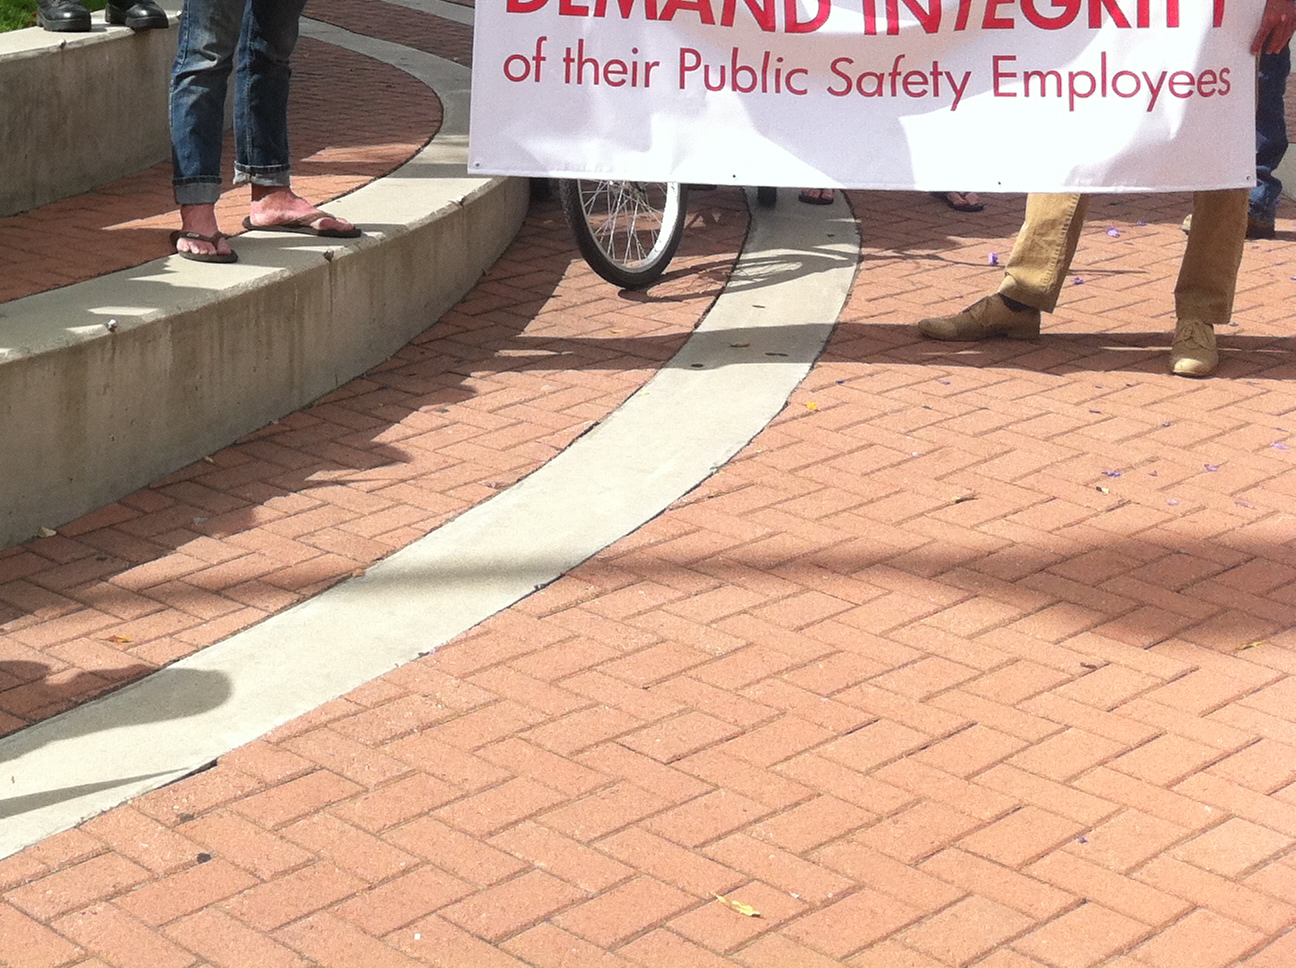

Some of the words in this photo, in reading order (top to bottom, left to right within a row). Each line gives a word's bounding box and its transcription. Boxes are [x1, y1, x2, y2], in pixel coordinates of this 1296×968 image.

[503, 36, 547, 83] of
[563, 38, 660, 88] their
[679, 47, 809, 95] Public
[827, 54, 972, 111] Safety
[992, 51, 1232, 112] Employees
